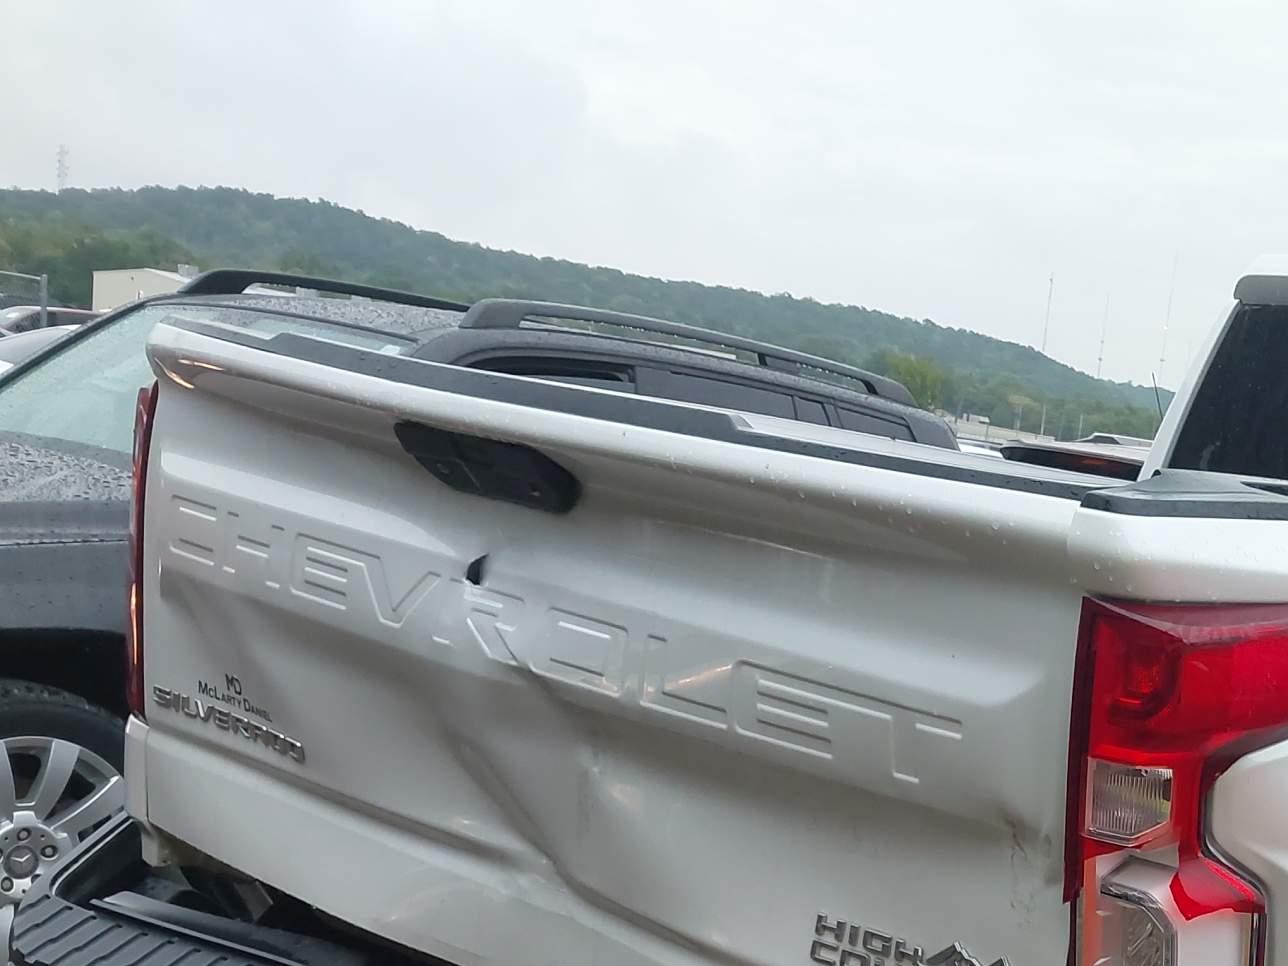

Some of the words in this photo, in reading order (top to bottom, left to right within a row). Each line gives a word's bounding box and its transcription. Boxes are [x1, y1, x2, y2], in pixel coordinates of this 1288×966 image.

[168, 494, 962, 784] CHEVROLET
[152, 684, 305, 765] SILVERADO
[815, 912, 924, 963] HIGH
